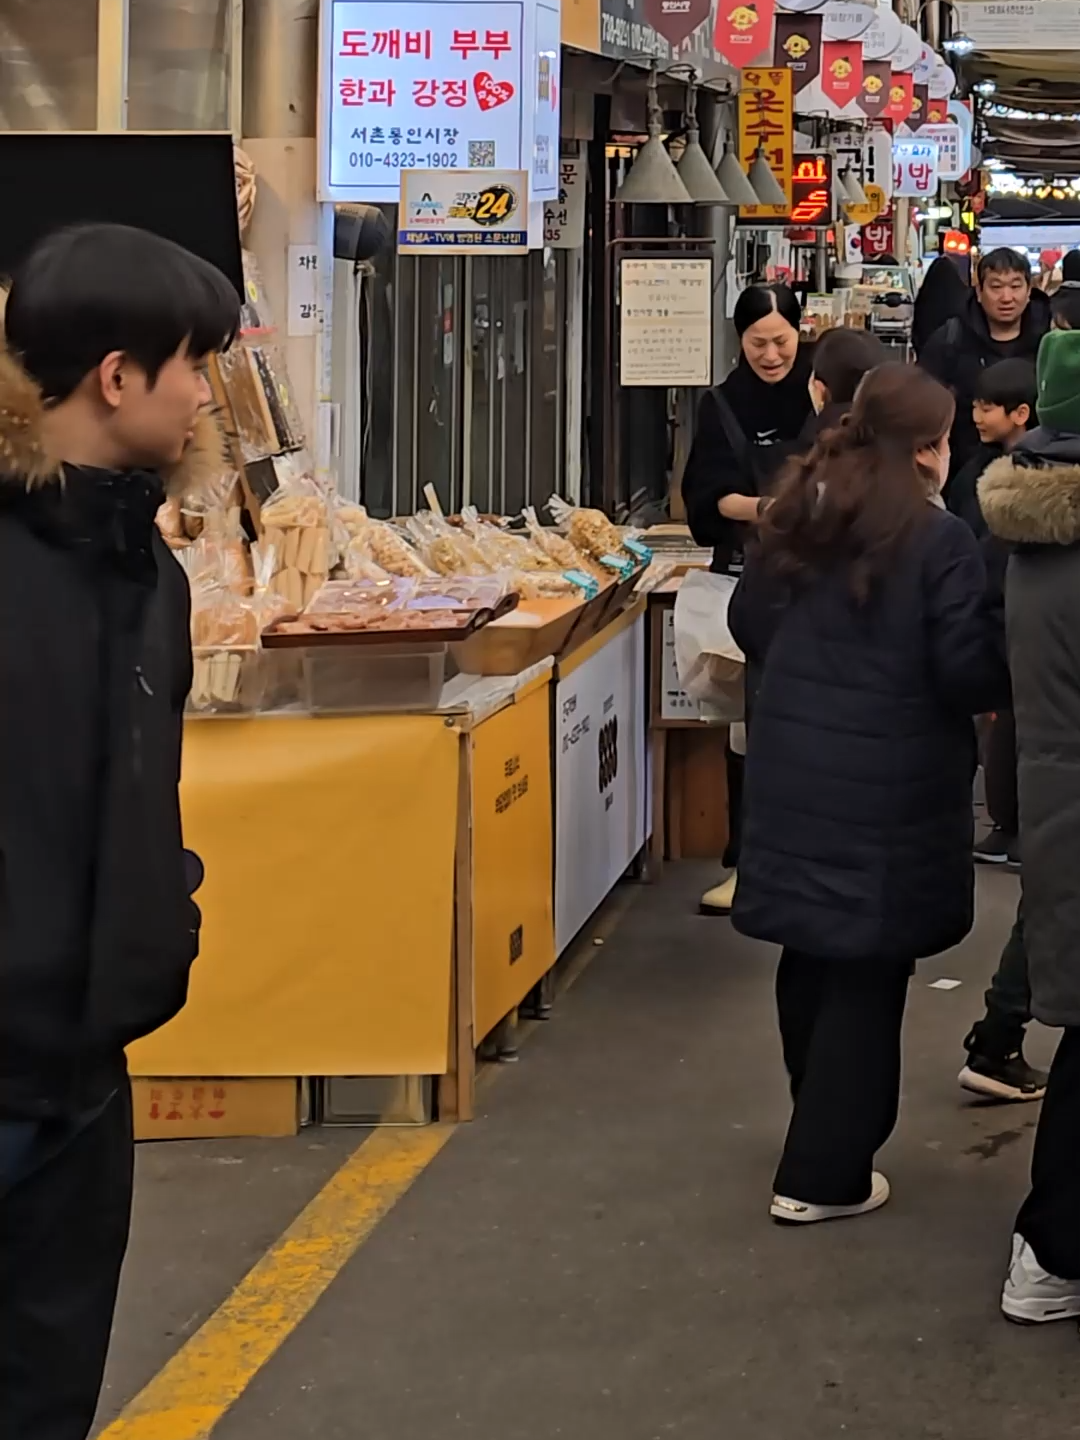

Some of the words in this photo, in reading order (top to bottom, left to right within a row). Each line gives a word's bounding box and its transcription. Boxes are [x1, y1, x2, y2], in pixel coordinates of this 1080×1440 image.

[339, 29, 431, 60] 도깨비
[449, 29, 512, 60] 부부
[339, 78, 396, 108] 한과
[412, 78, 467, 108] 강정
[350, 126, 460, 146] 서촌통인시장
[349, 151, 458, 168] 010-4323-1902
[476, 192, 510, 219] 24
[543, 208, 568, 226] 수선
